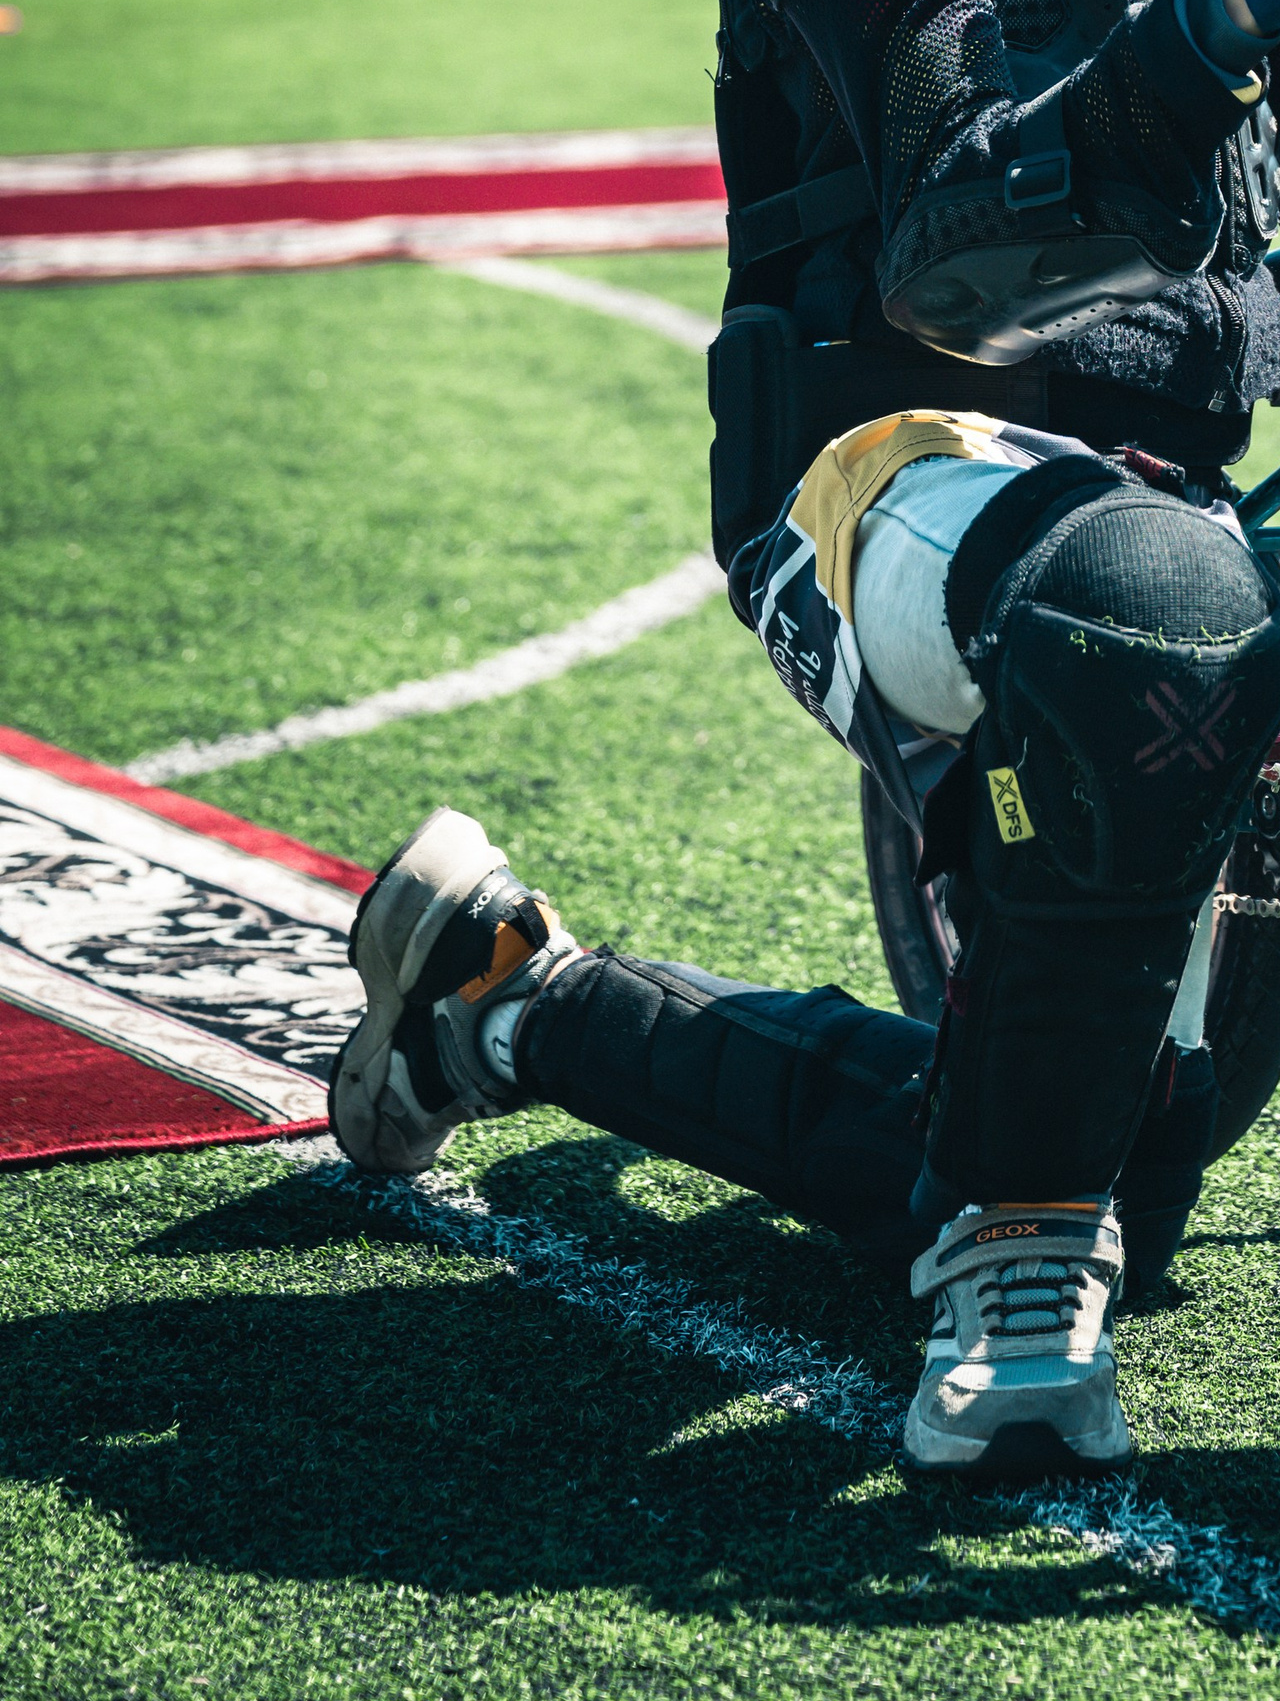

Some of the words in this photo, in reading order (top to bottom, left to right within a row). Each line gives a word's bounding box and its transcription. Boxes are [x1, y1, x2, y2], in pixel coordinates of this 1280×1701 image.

[1003, 801, 1022, 838] DFS
[467, 876, 508, 919] GEOX
[976, 1223, 1040, 1244] GEOX
